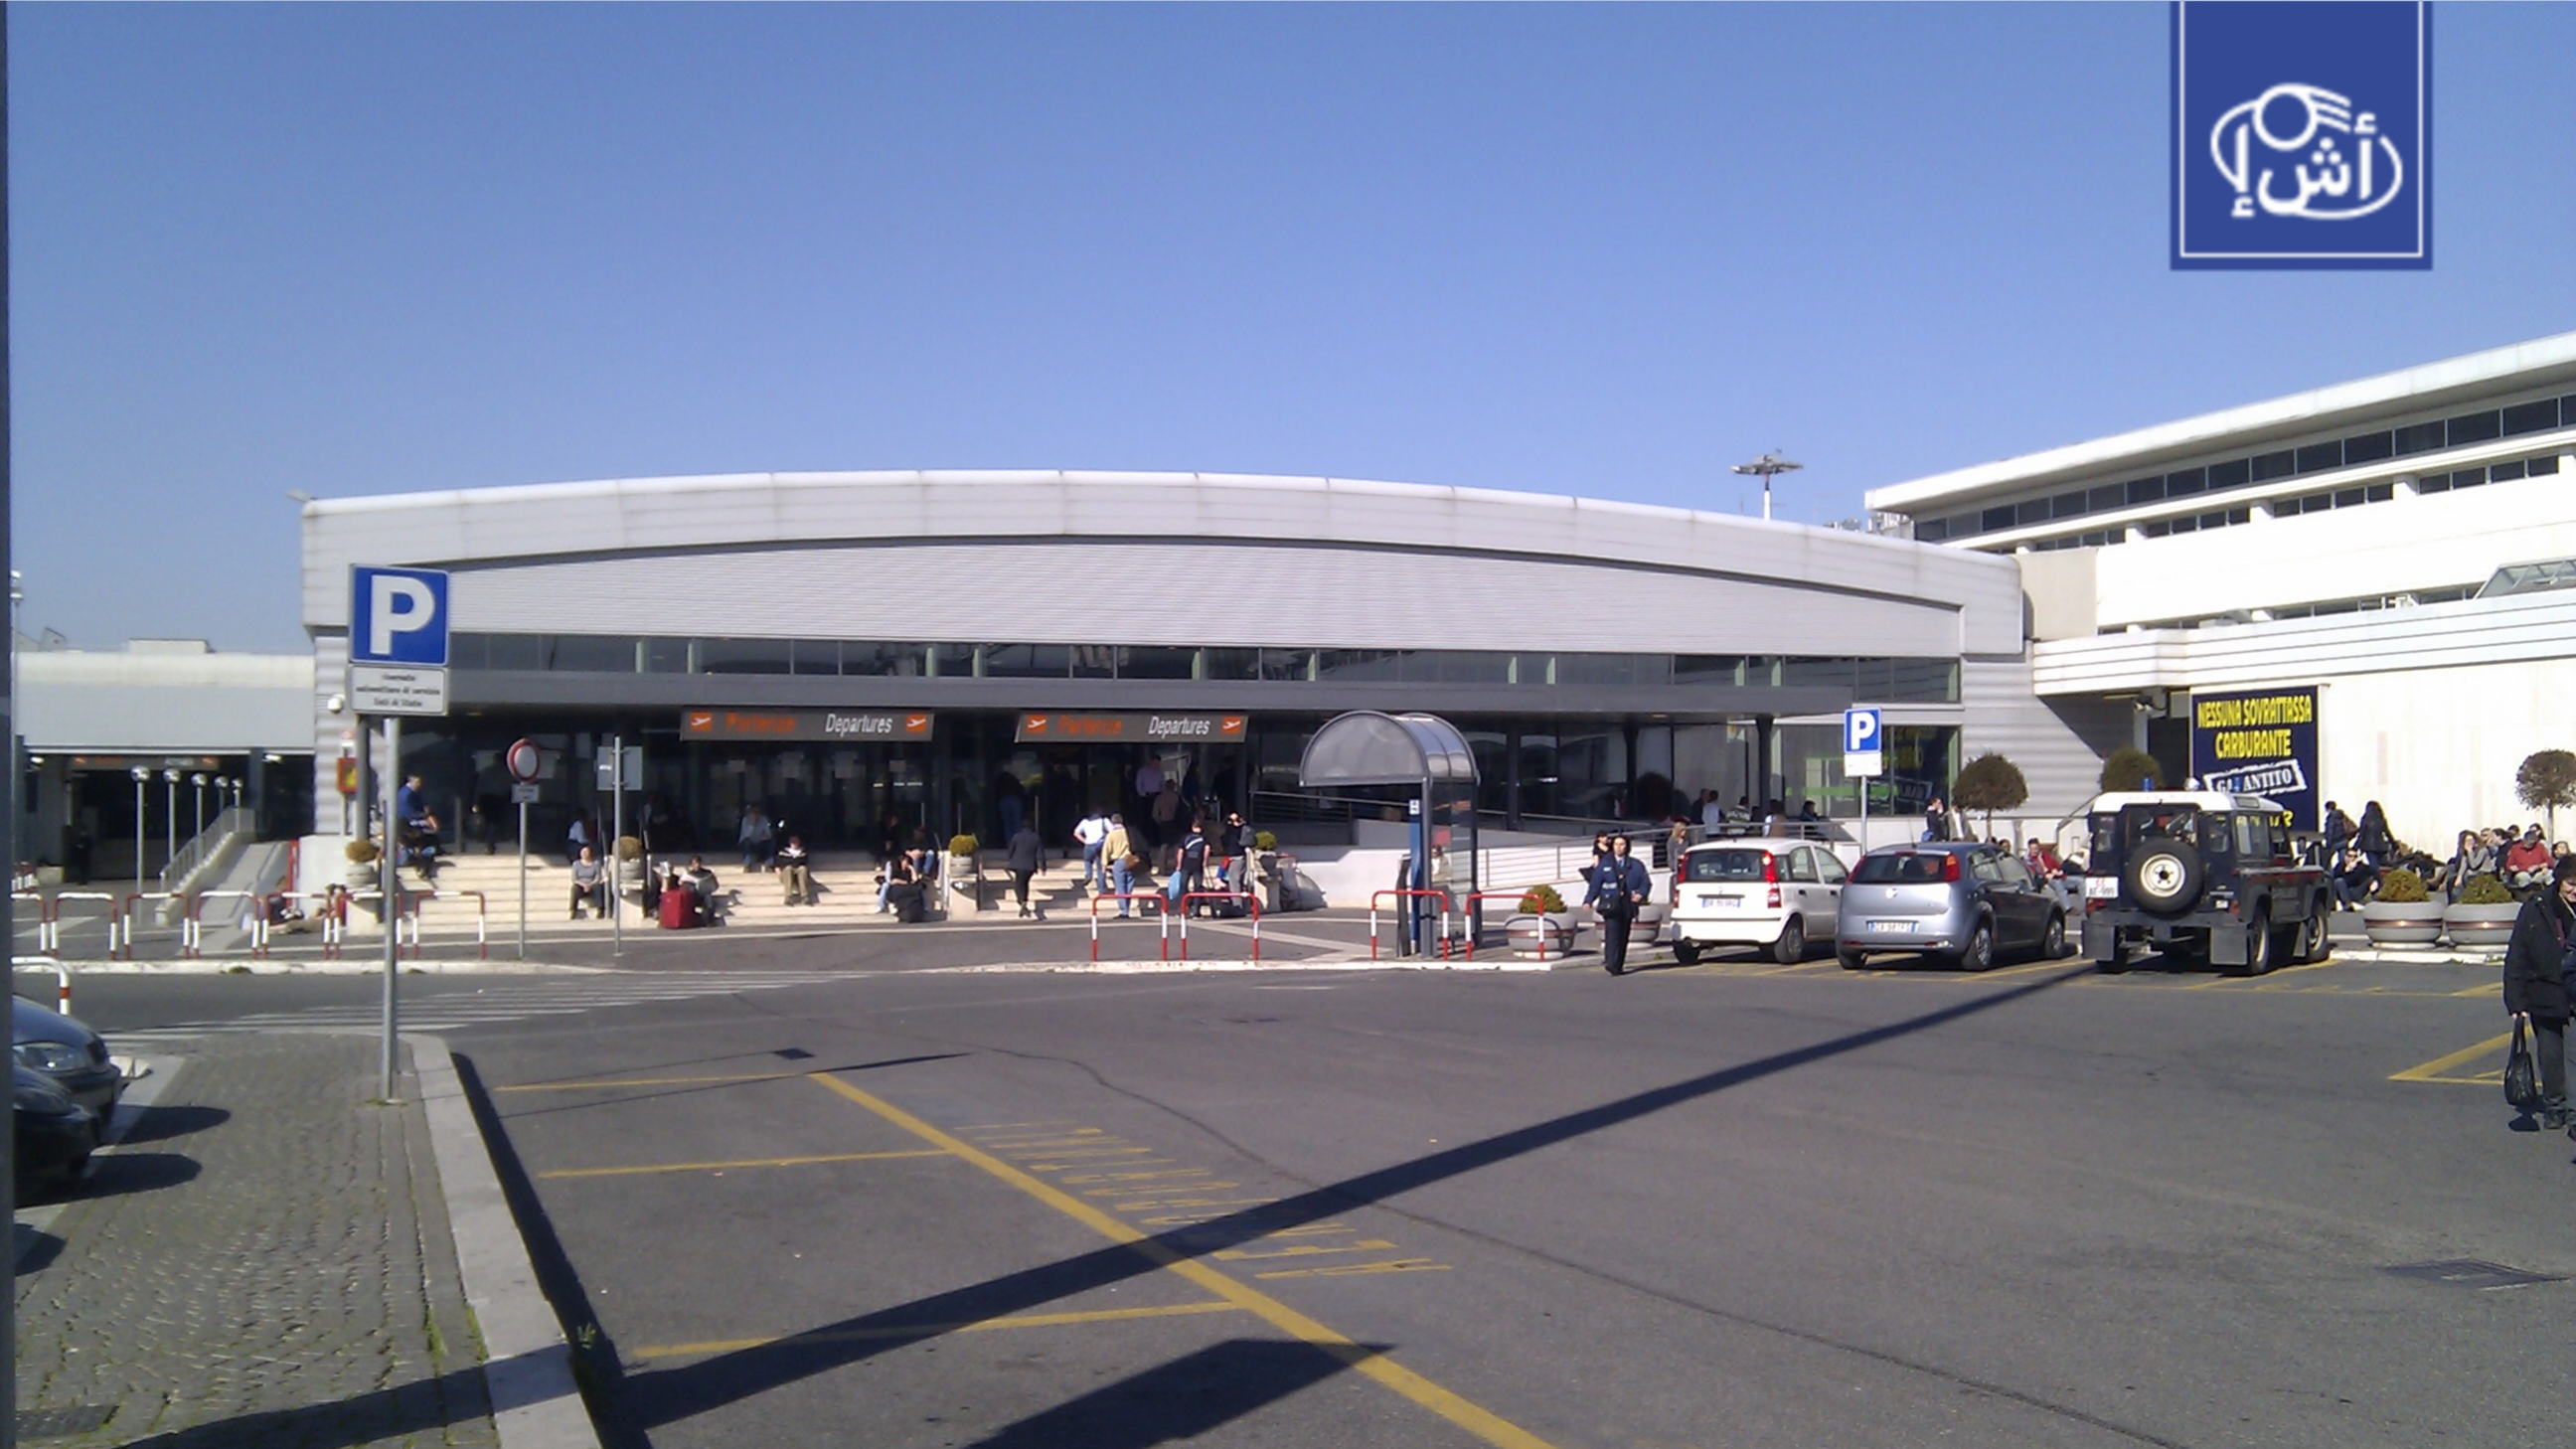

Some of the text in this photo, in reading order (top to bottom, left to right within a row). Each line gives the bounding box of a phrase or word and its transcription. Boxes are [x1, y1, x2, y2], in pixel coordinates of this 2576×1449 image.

[370, 574, 435, 656] P
[825, 713, 893, 737] Departures
[2197, 695, 2313, 728] NESSUNA SOVRATTASSA
[1149, 716, 1210, 738] Departures
[1851, 712, 1875, 750] P
[2215, 729, 2292, 759] CARBURANTE
[2216, 768, 2293, 793] GAANTITO
